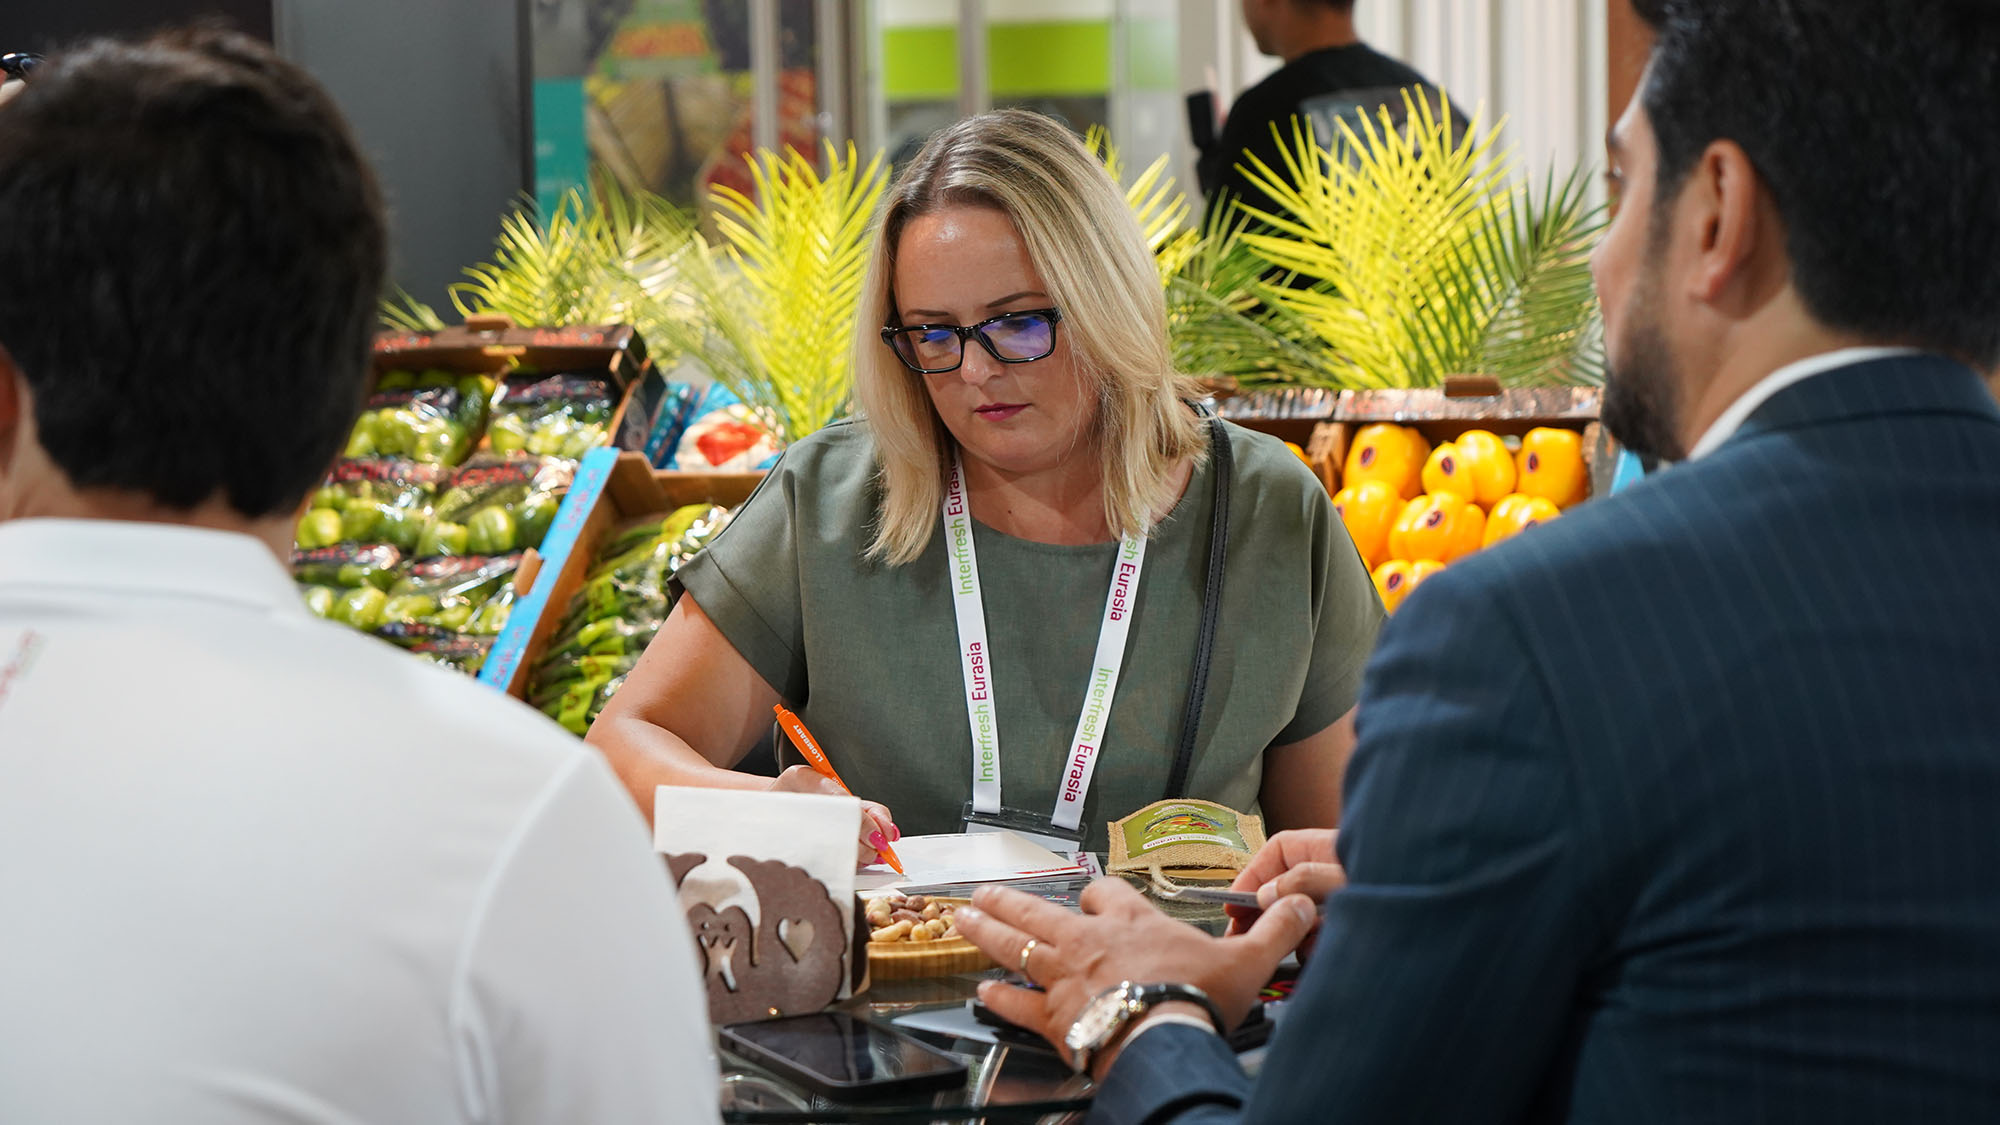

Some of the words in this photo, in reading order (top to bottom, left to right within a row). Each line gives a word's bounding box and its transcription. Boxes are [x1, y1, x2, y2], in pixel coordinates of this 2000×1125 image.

[949, 517, 974, 596] Interfresh
[1110, 562, 1136, 622] Eurasia
[966, 641, 987, 701] Eurasia
[1080, 667, 1113, 742] Interfresh
[974, 703, 994, 782] Interfresh
[1064, 743, 1094, 803] Eurasia
